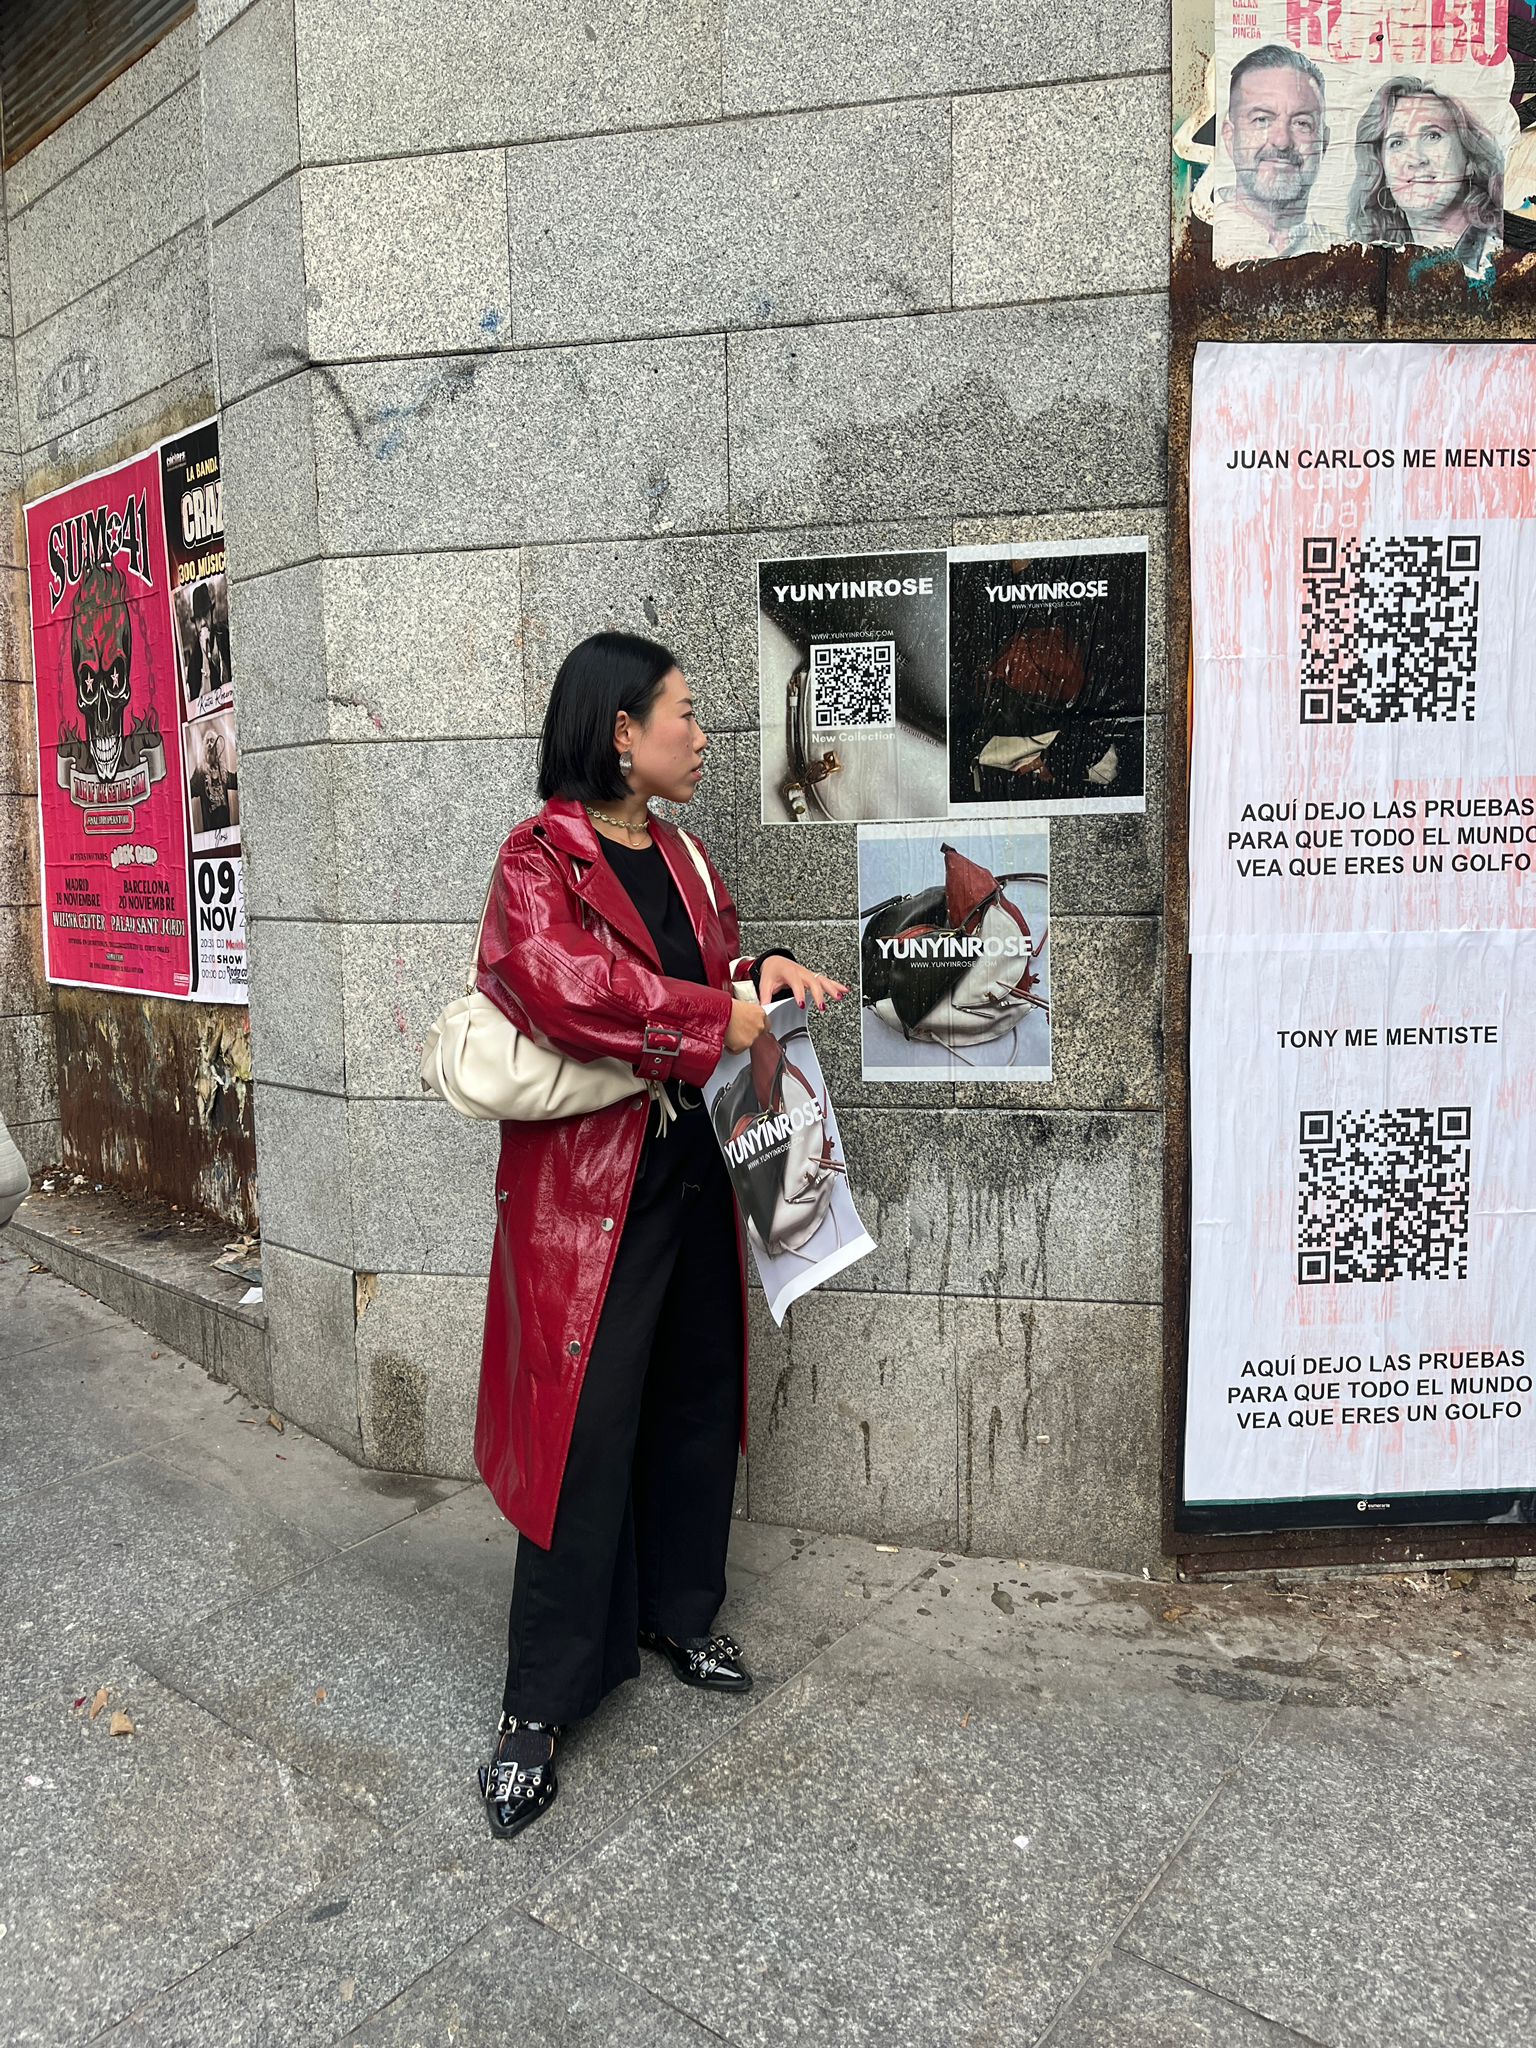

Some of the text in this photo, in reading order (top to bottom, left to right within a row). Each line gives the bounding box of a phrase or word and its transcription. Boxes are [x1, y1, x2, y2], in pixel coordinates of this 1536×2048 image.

[1232, 14, 1257, 26] MANU
[1227, 449, 1289, 469] JUAN
[1298, 449, 1395, 469] CARLOS
[1403, 449, 1436, 468] ME
[186, 466, 195, 483] LA
[48, 487, 152, 613] SUM 41
[179, 562, 196, 585] 300
[773, 577, 933, 603] YUNYINROSE
[985, 580, 1108, 603] YUNYINROSE
[811, 733, 836, 743] New
[838, 731, 895, 742] Collection
[1241, 798, 1534, 822] AQUÍ DEJO LAS PRUEBAS
[1228, 831, 1288, 849] PARA
[1295, 830, 1343, 849] QUE
[1351, 828, 1414, 847] TODO
[1423, 827, 1450, 845] EL
[1236, 853, 1531, 877] VEA QUE ERES UN GOLFO
[65, 878, 89, 891] MADRID
[123, 880, 170, 894] BARCELONA
[198, 861, 235, 905] 09
[64, 893, 100, 907] NOVIEMBRE
[118, 895, 175, 911] 20 NOVIEMBRE
[136, 917, 159, 934] SANT
[161, 918, 185, 936] JORDI
[201, 906, 236, 932] NOV
[217, 939, 225, 948] DJ
[876, 936, 1032, 959] YUNYINROSE
[217, 954, 243, 965] SHOW
[1277, 1026, 1498, 1049] TONY ME MENTISTE
[724, 1097, 824, 1168] YUNYINROSE
[1241, 1350, 1525, 1378] AQUÍ DEJO LAS PRUEBAS
[1228, 1375, 1533, 1403] PARA QUE TODO EL MUNDO
[1237, 1401, 1522, 1429] VEA QUE ERES UN GOLFO
